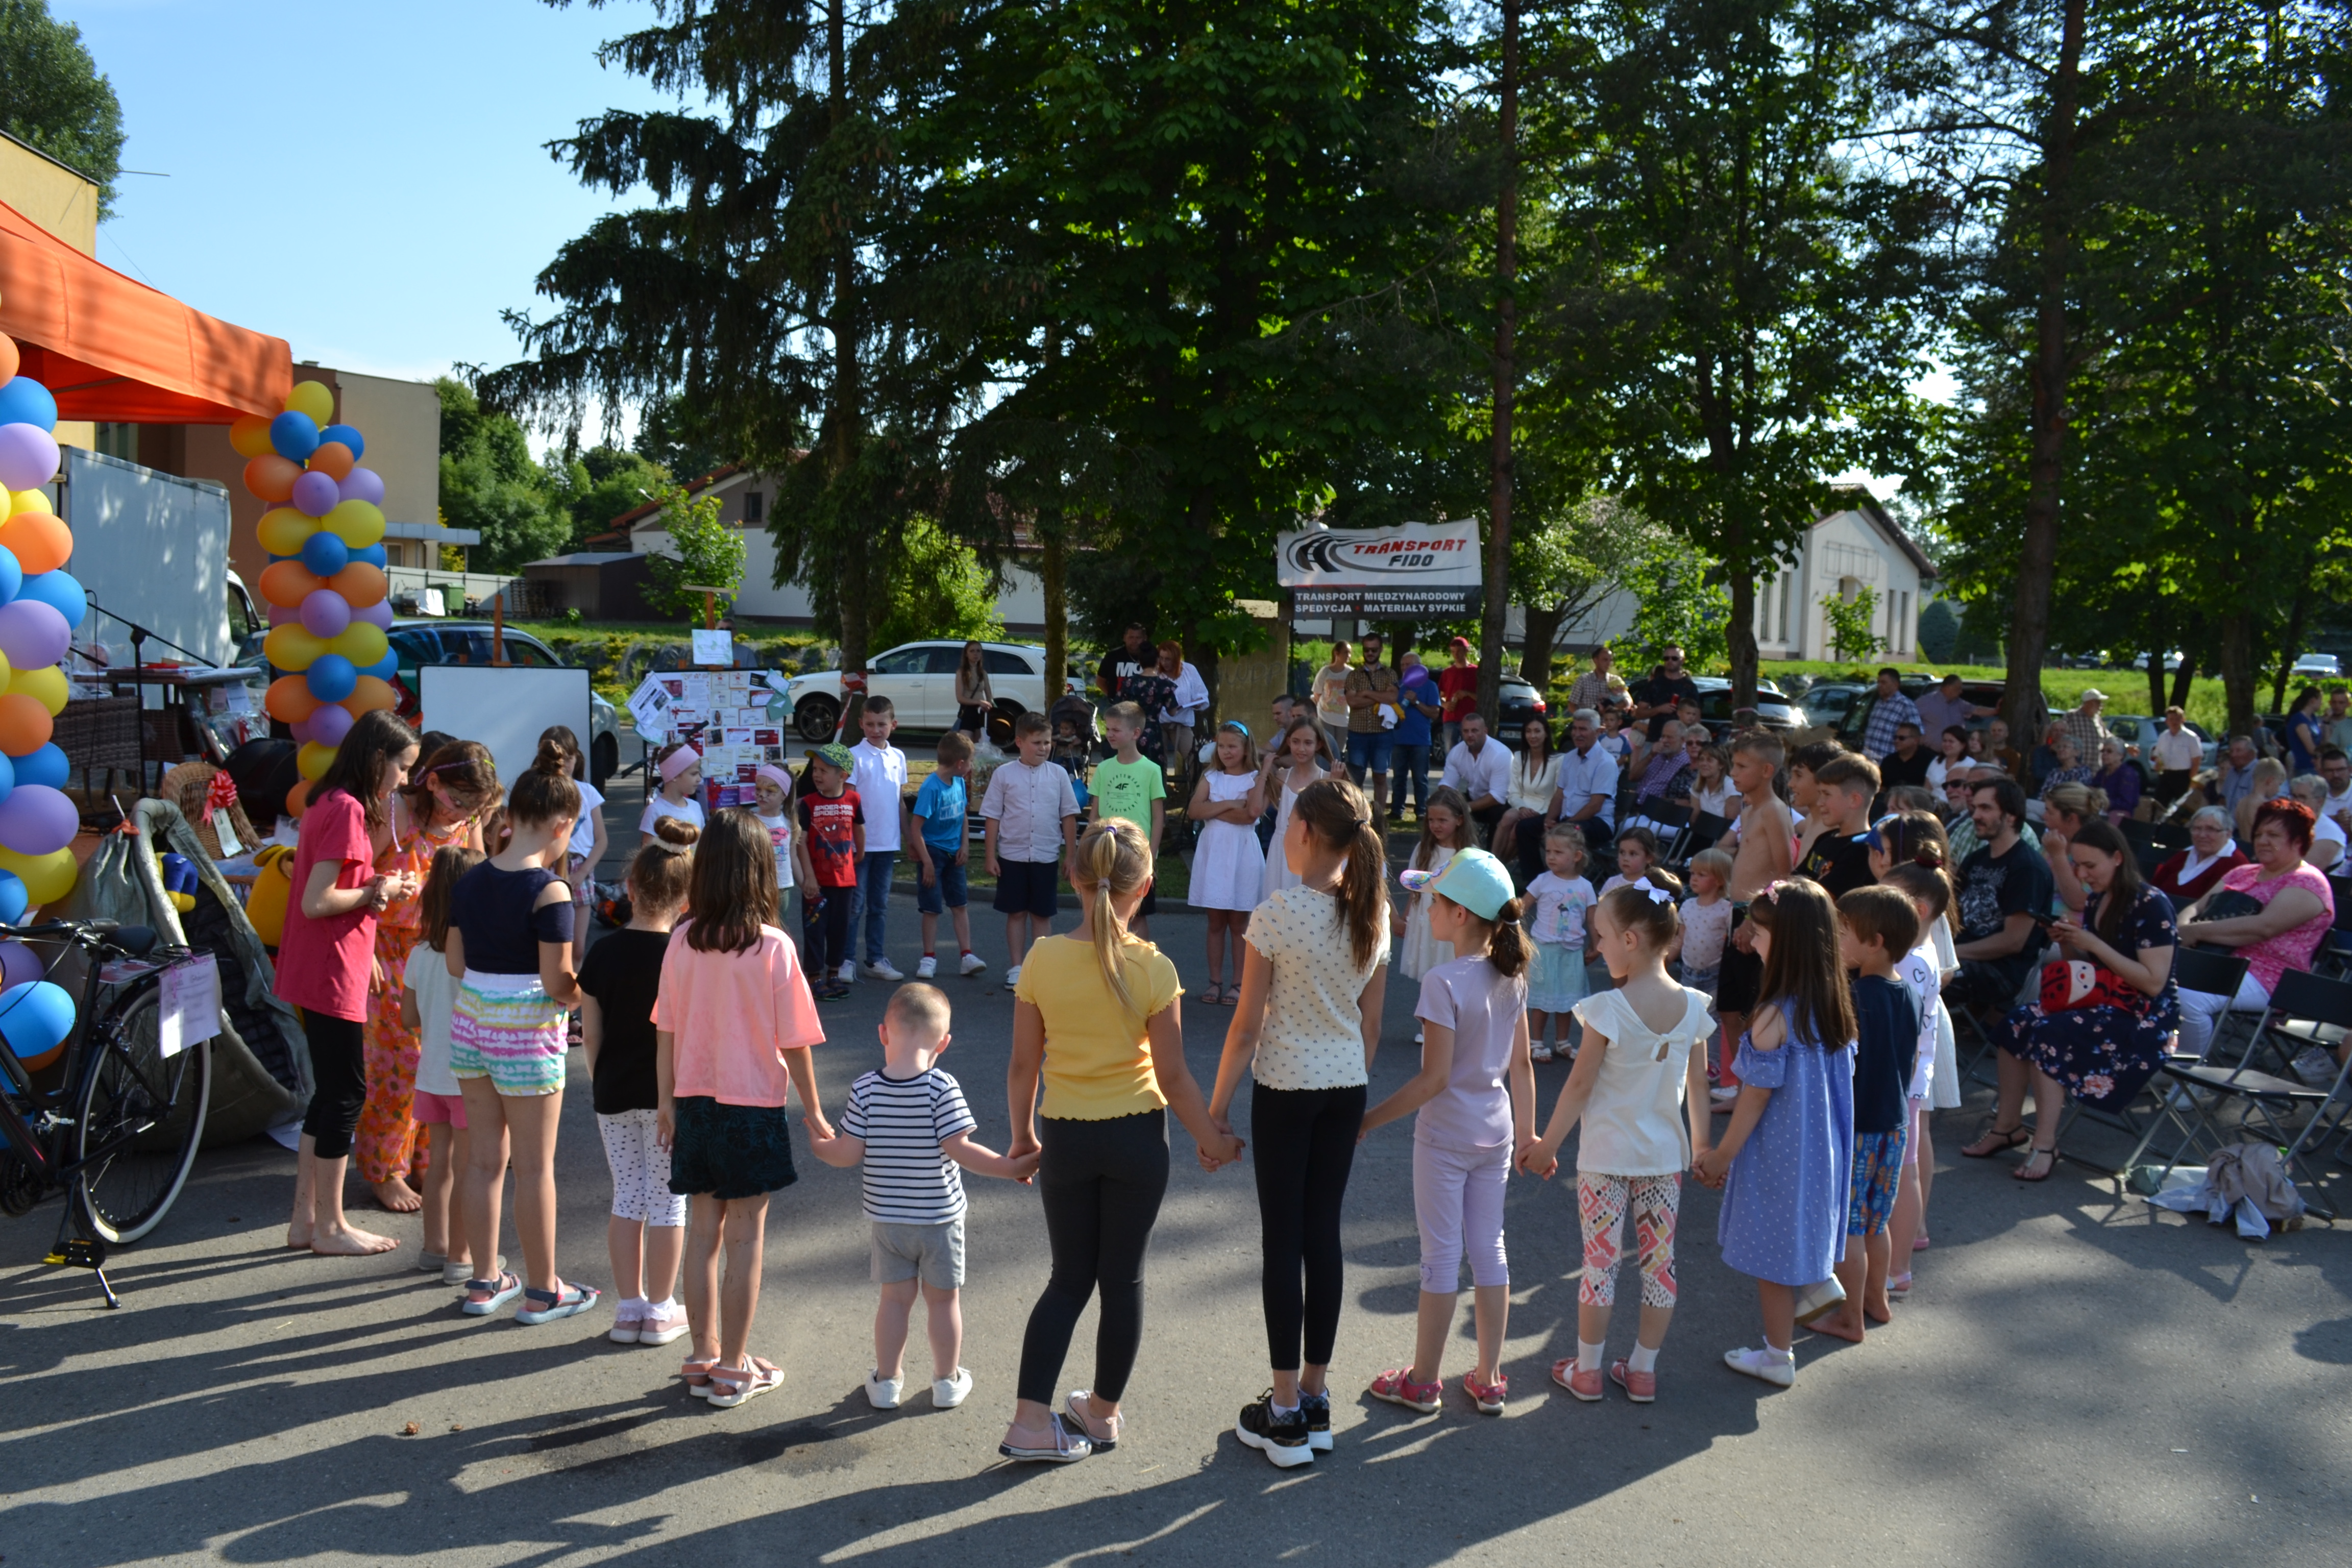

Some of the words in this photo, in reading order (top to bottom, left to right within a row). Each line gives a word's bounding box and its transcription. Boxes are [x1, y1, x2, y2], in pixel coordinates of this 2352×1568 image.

[1354, 539, 1466, 554] TRANSPORT
[1388, 554, 1434, 567] FIDO
[1296, 593, 1361, 601] TRANSPORT
[1364, 593, 1465, 602] MIĘDZYNARODOWY
[1295, 604, 1352, 612] SPEDYCJA
